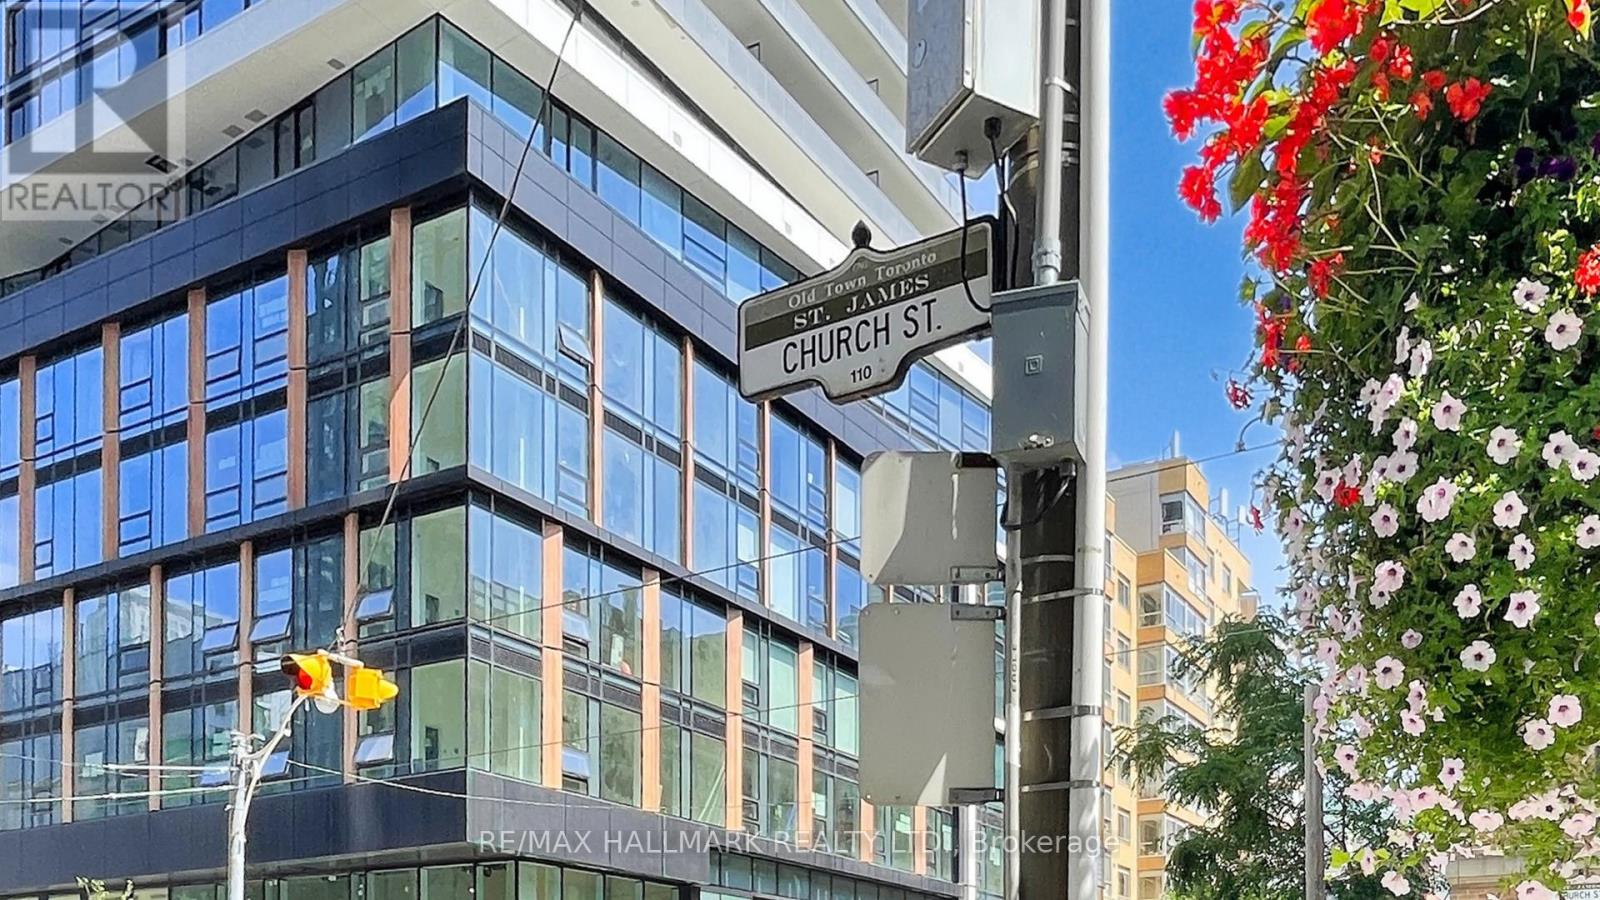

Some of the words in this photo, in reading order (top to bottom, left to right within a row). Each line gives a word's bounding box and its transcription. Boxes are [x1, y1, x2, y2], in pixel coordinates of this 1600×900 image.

[788, 288, 816, 309] Old
[825, 274, 866, 297] Town
[875, 252, 937, 281] Toronto
[794, 307, 831, 330] ST.
[846, 274, 930, 313] JAMES
[783, 312, 890, 374] CHURCH
[903, 299, 942, 339] ST.
[850, 366, 872, 383] 110
